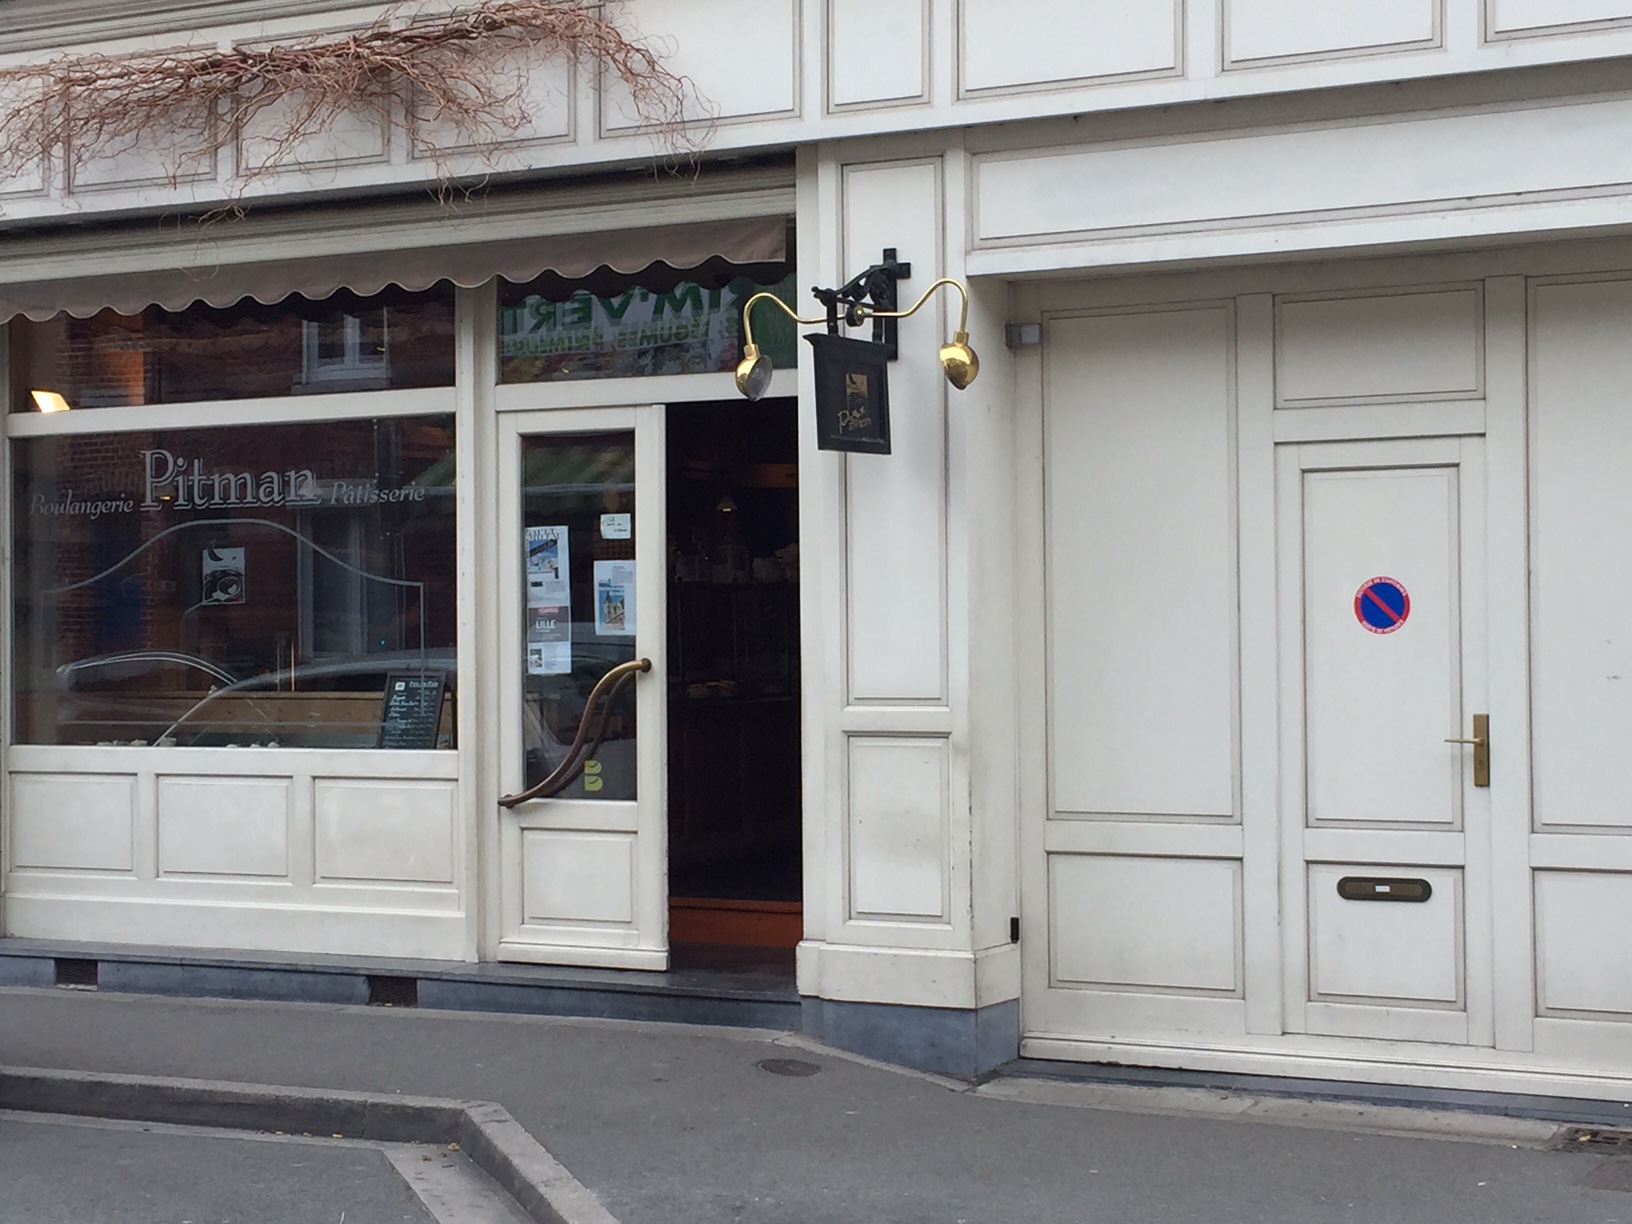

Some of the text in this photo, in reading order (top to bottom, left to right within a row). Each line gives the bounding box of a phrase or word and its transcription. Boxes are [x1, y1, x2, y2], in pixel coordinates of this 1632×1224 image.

[29, 449, 425, 520] Boulangerie Pitman Pâtisserie
